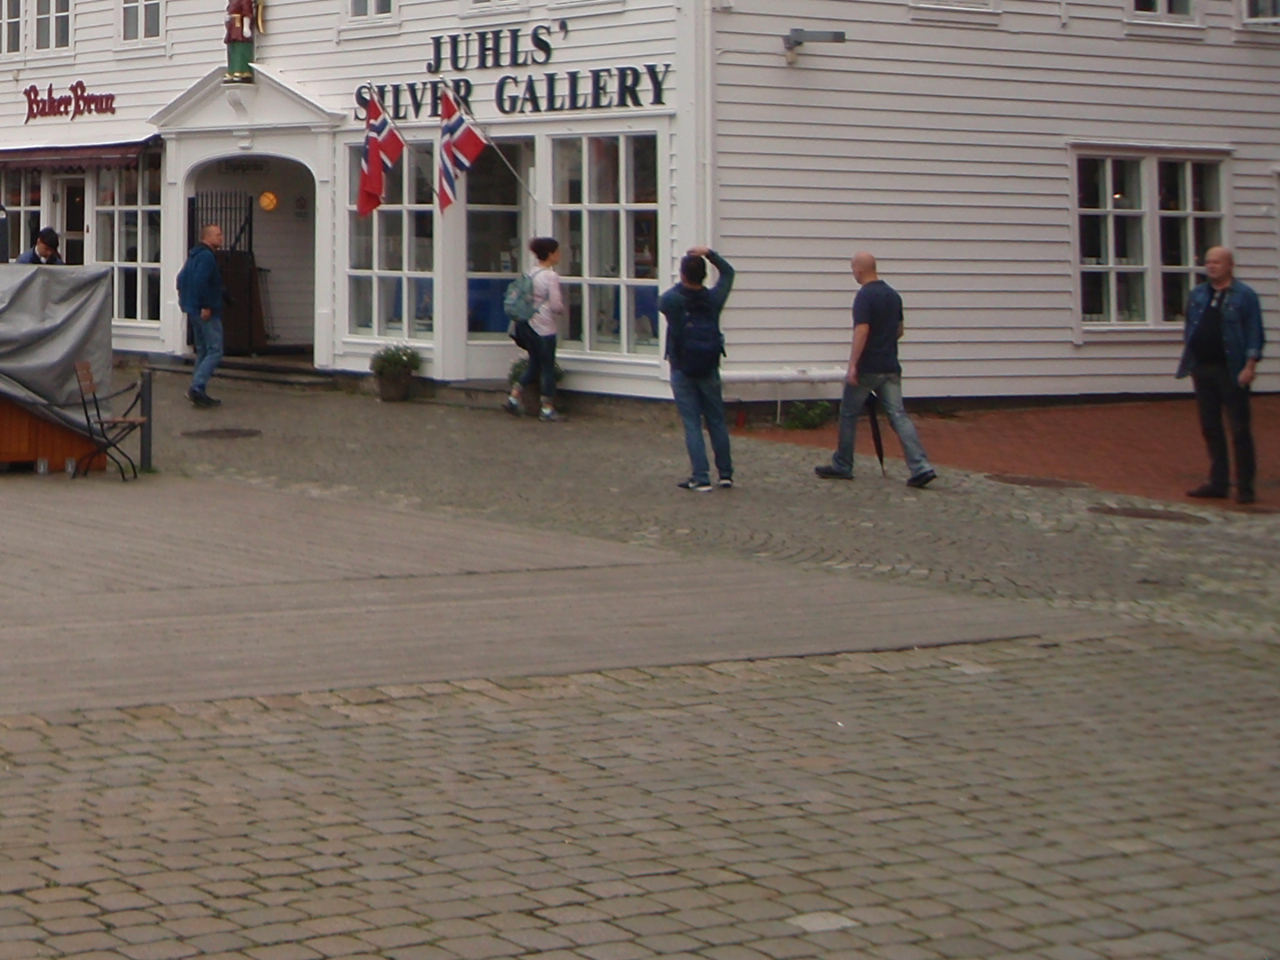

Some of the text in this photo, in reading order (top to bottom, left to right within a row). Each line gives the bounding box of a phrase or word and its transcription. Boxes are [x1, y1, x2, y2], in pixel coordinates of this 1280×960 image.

[426, 19, 569, 74] JUHLS'
[23, 80, 116, 124] Baker Brun
[353, 63, 671, 122] SILVER GALLERY
